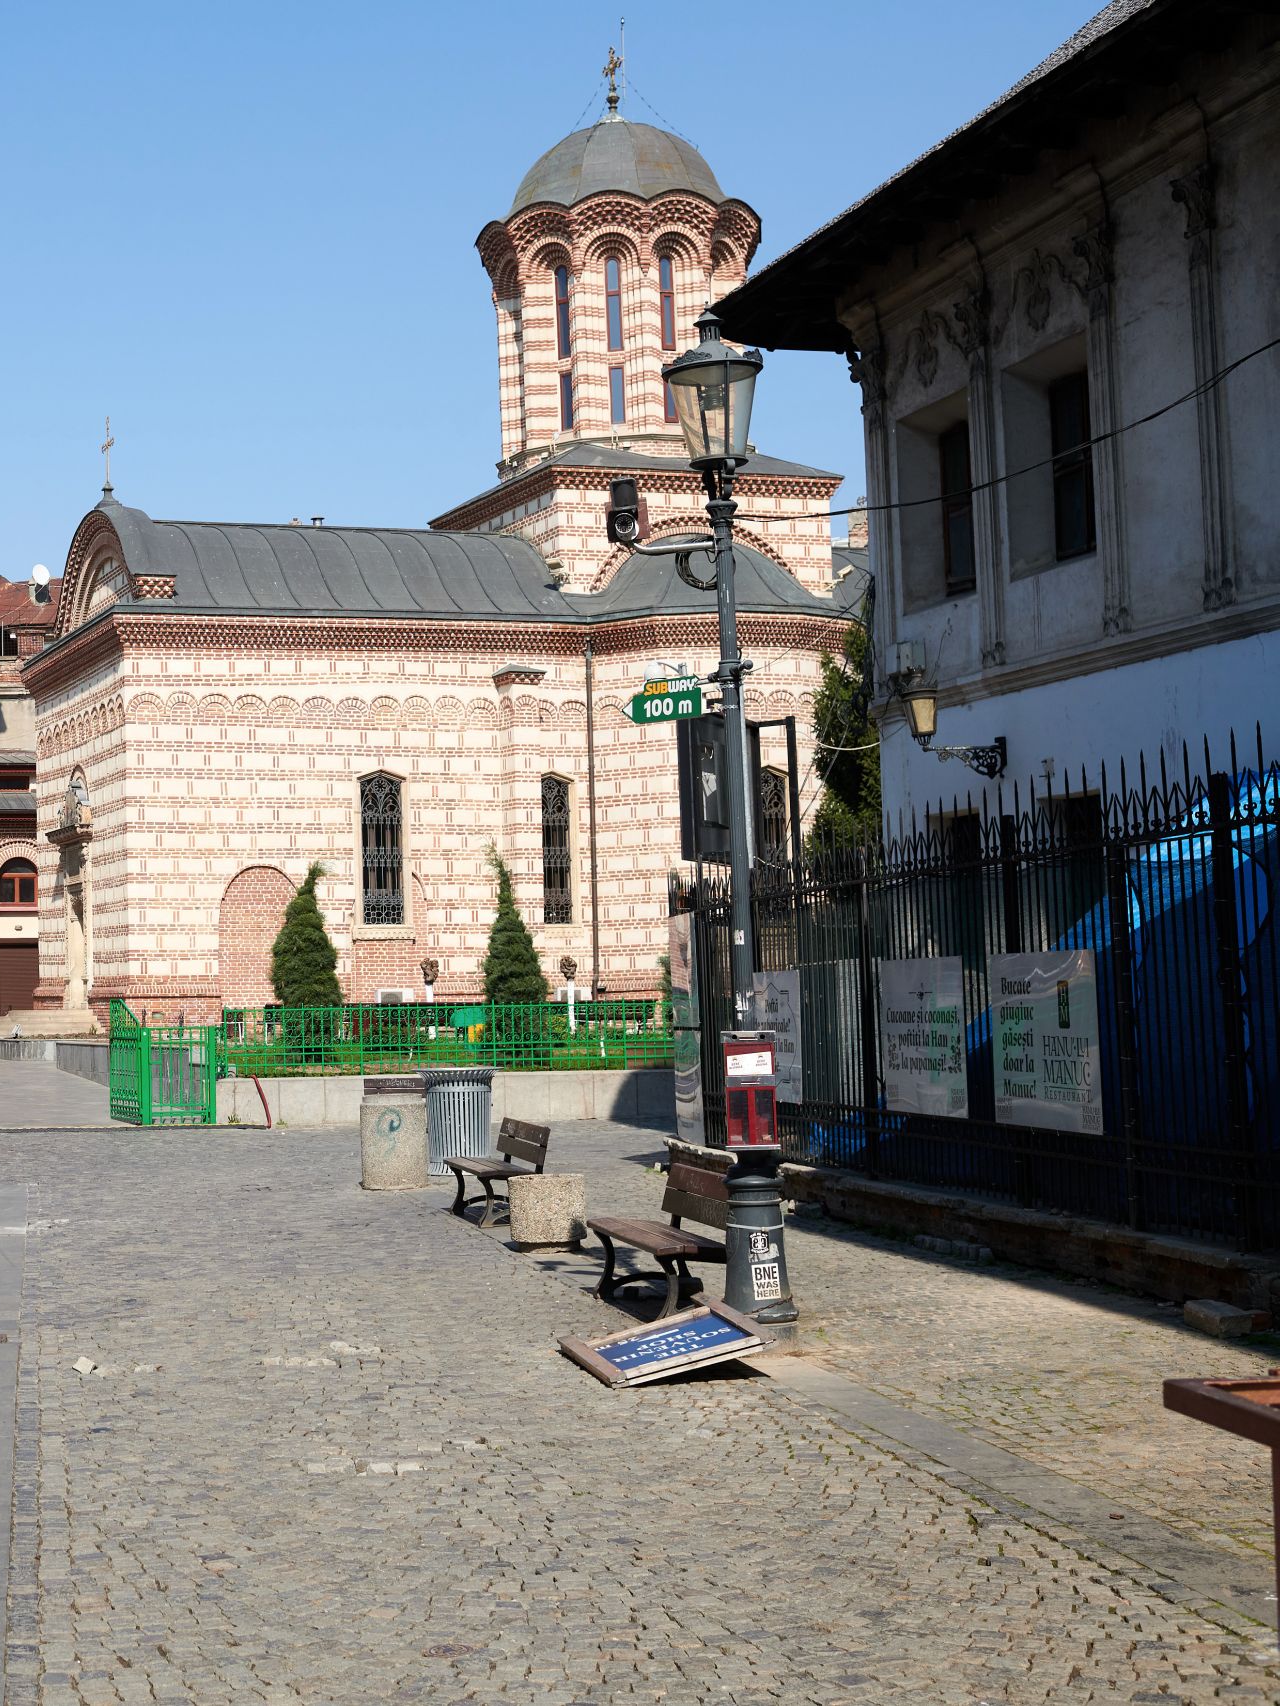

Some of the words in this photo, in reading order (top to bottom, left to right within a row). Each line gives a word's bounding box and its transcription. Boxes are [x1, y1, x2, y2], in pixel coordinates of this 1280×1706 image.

[644, 679, 695, 696] SUBWAY
[643, 698, 674, 718] 100
[678, 700, 692, 714] m
[1001, 977, 1031, 995] Bucate
[886, 1007, 916, 1024] Cucoane
[917, 1006, 924, 1028] și
[924, 1006, 960, 1029] coconași,
[1000, 1002, 1034, 1025] giugiuc
[922, 1030, 930, 1047] la
[931, 1030, 948, 1048] Han
[1002, 1027, 1034, 1052] găsești
[901, 1052, 909, 1070] la
[909, 1054, 947, 1077] papanași!
[1003, 1052, 1024, 1072] doar
[1025, 1053, 1035, 1073] la
[1003, 1078, 1037, 1100] Manuc!
[754, 1266, 778, 1281] BNE
[756, 1280, 779, 1290] WAS
[756, 1289, 780, 1298] HERE
[610, 1327, 732, 1363] SOUVENIR
[635, 1330, 697, 1351] SHOP
[653, 1343, 705, 1359] THE
